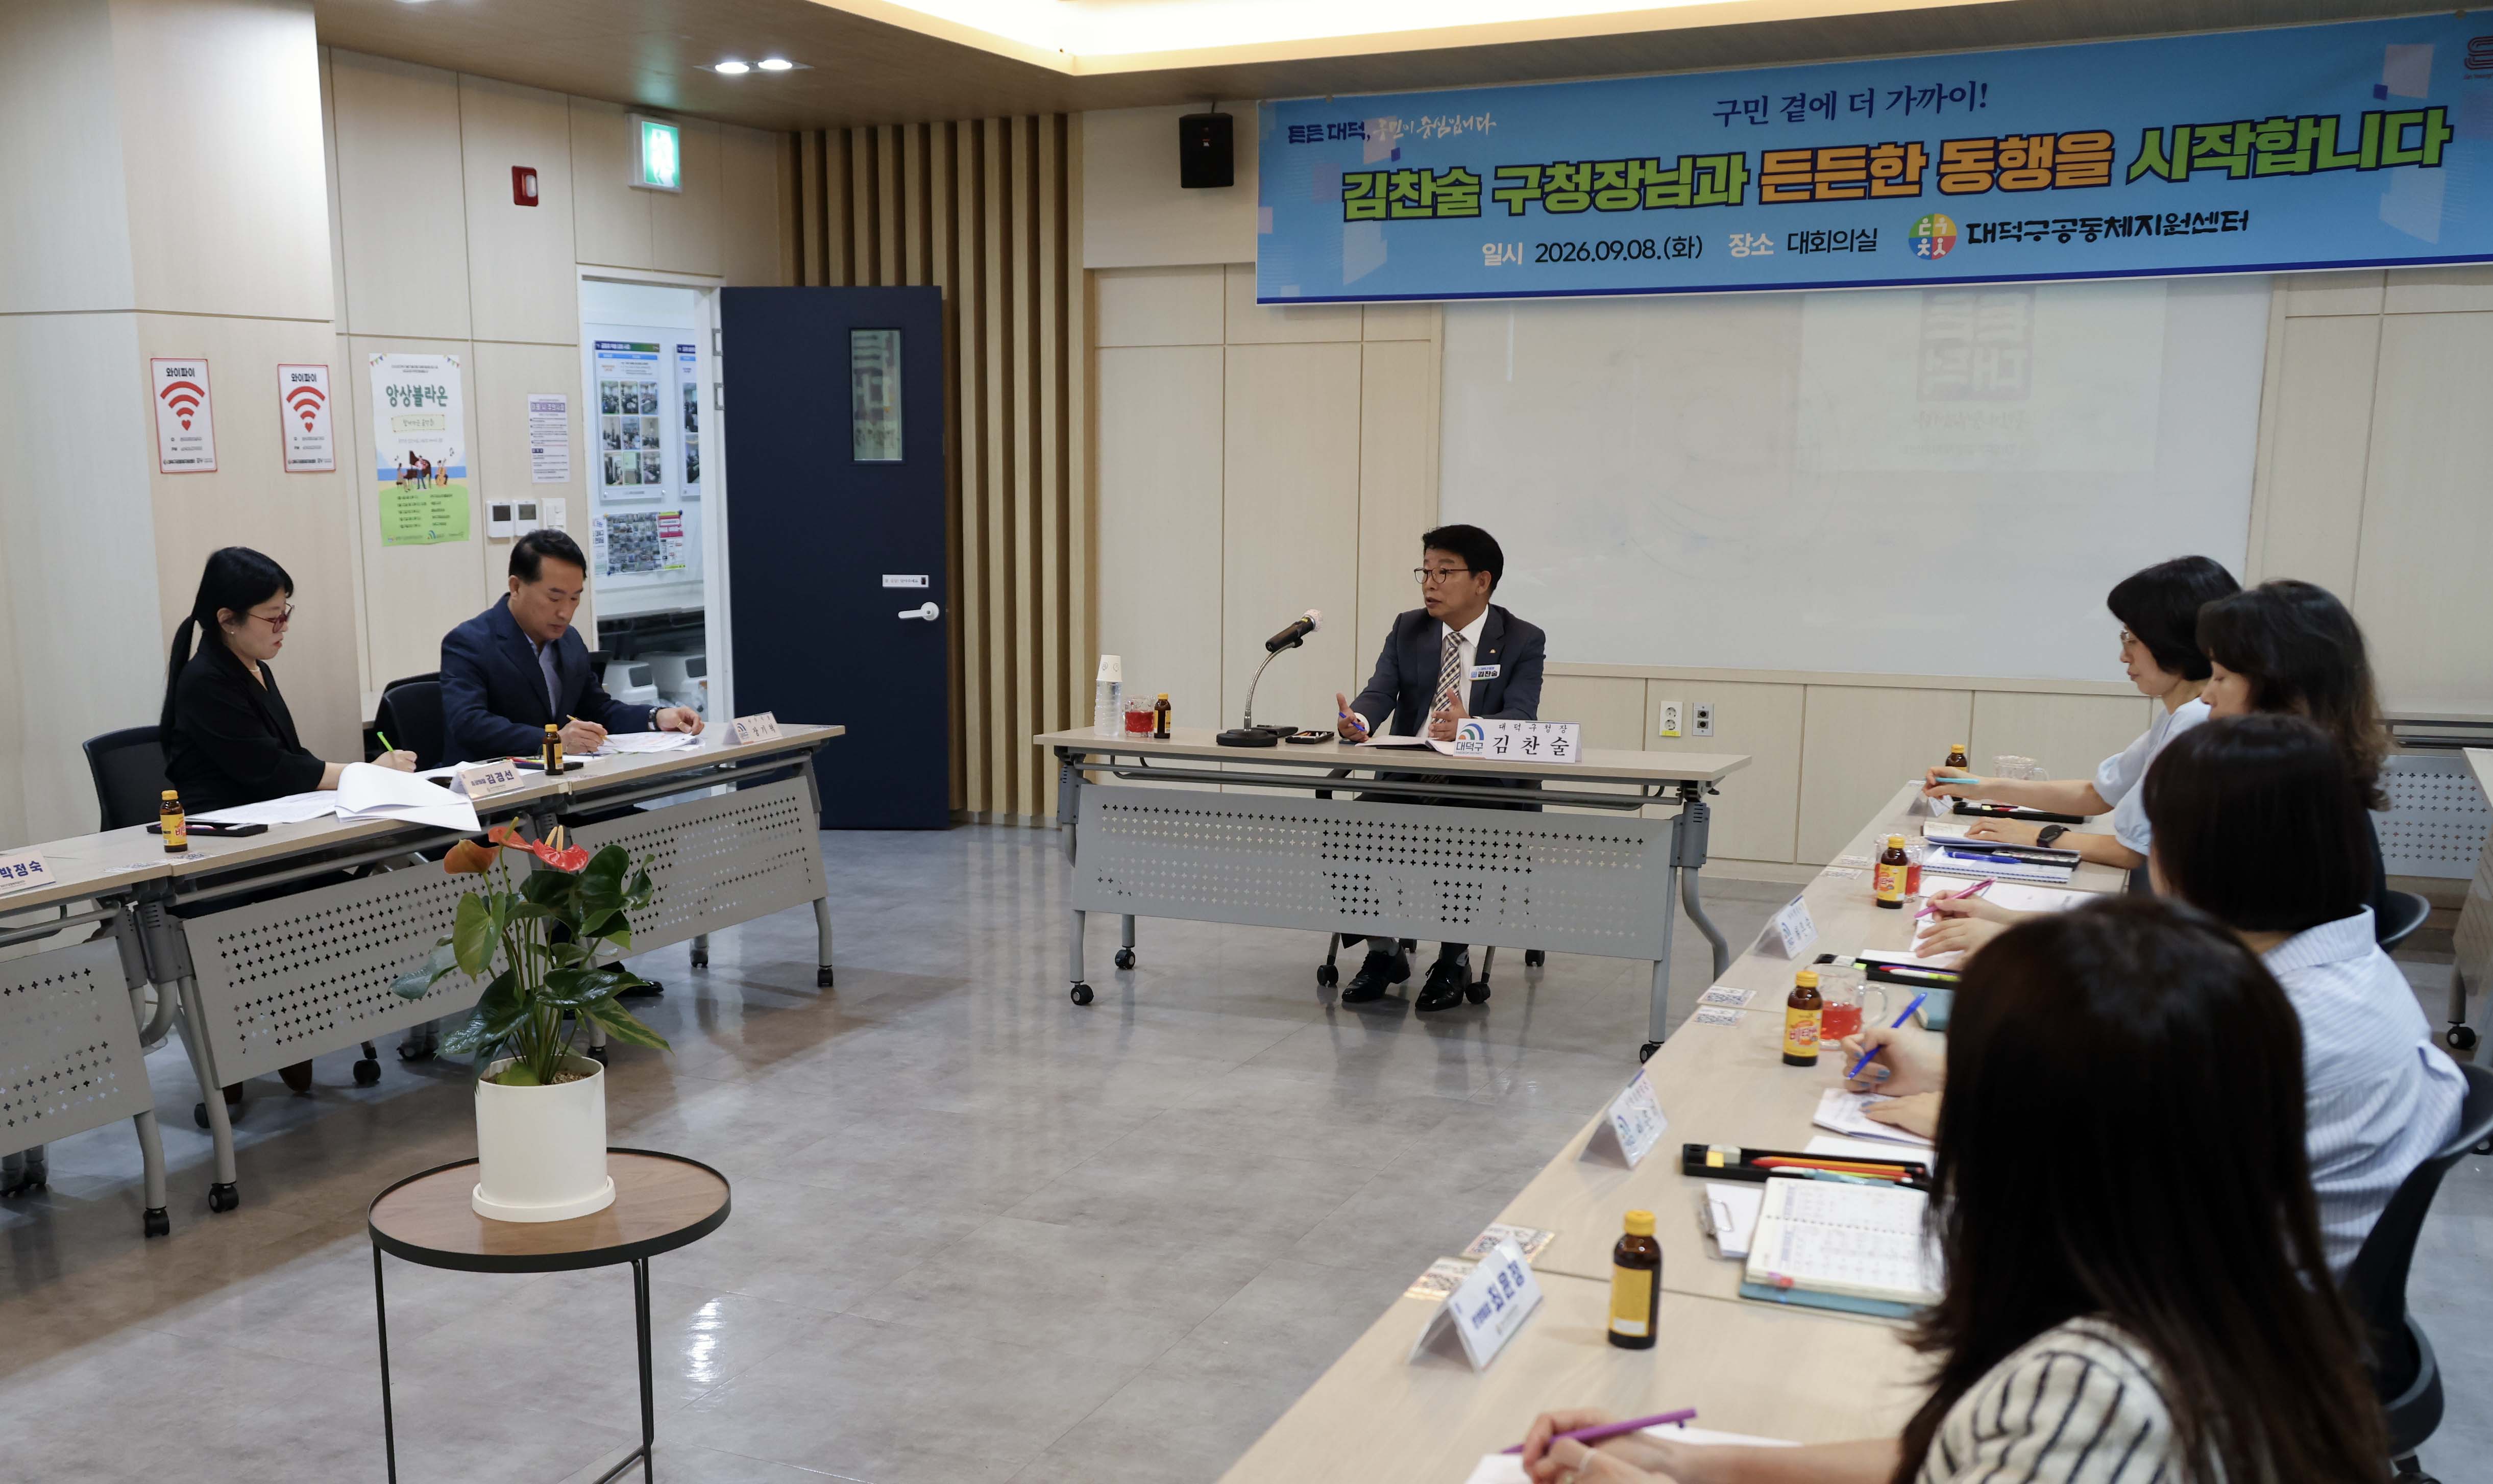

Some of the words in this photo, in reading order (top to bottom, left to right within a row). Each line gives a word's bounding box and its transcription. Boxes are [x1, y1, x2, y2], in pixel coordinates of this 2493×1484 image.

[1713, 95, 1769, 127] 구민
[1780, 91, 1838, 123] 곁에
[1849, 88, 1875, 118] 더
[1886, 81, 1988, 115] 가까이!
[1327, 121, 1371, 141] 대덕,
[1416, 112, 1497, 139] 중심입니다
[1341, 167, 1482, 222] 김찬술
[1493, 152, 1749, 215] 구청장님과
[1758, 140, 1929, 205] 든든한
[1936, 128, 2115, 196] 동행을
[2125, 105, 2454, 184] 시작합니다
[1967, 210, 2249, 244] 대덕구공동체지원센터
[1481, 242, 1523, 266] 일시
[1534, 236, 1704, 264] 2026.09.08.(화)
[1727, 232, 1774, 258] 장소
[1787, 227, 1878, 255] 대회의실
[166, 367, 195, 378] 와이파이
[291, 373, 317, 382] 와이파이
[385, 384, 448, 407] 앙상블라온
[1456, 742, 1483, 751] 대덕구
[1492, 735, 1569, 756] 김찬술
[485, 770, 514, 784] 김경선
[0, 860, 43, 879] 박정숙
